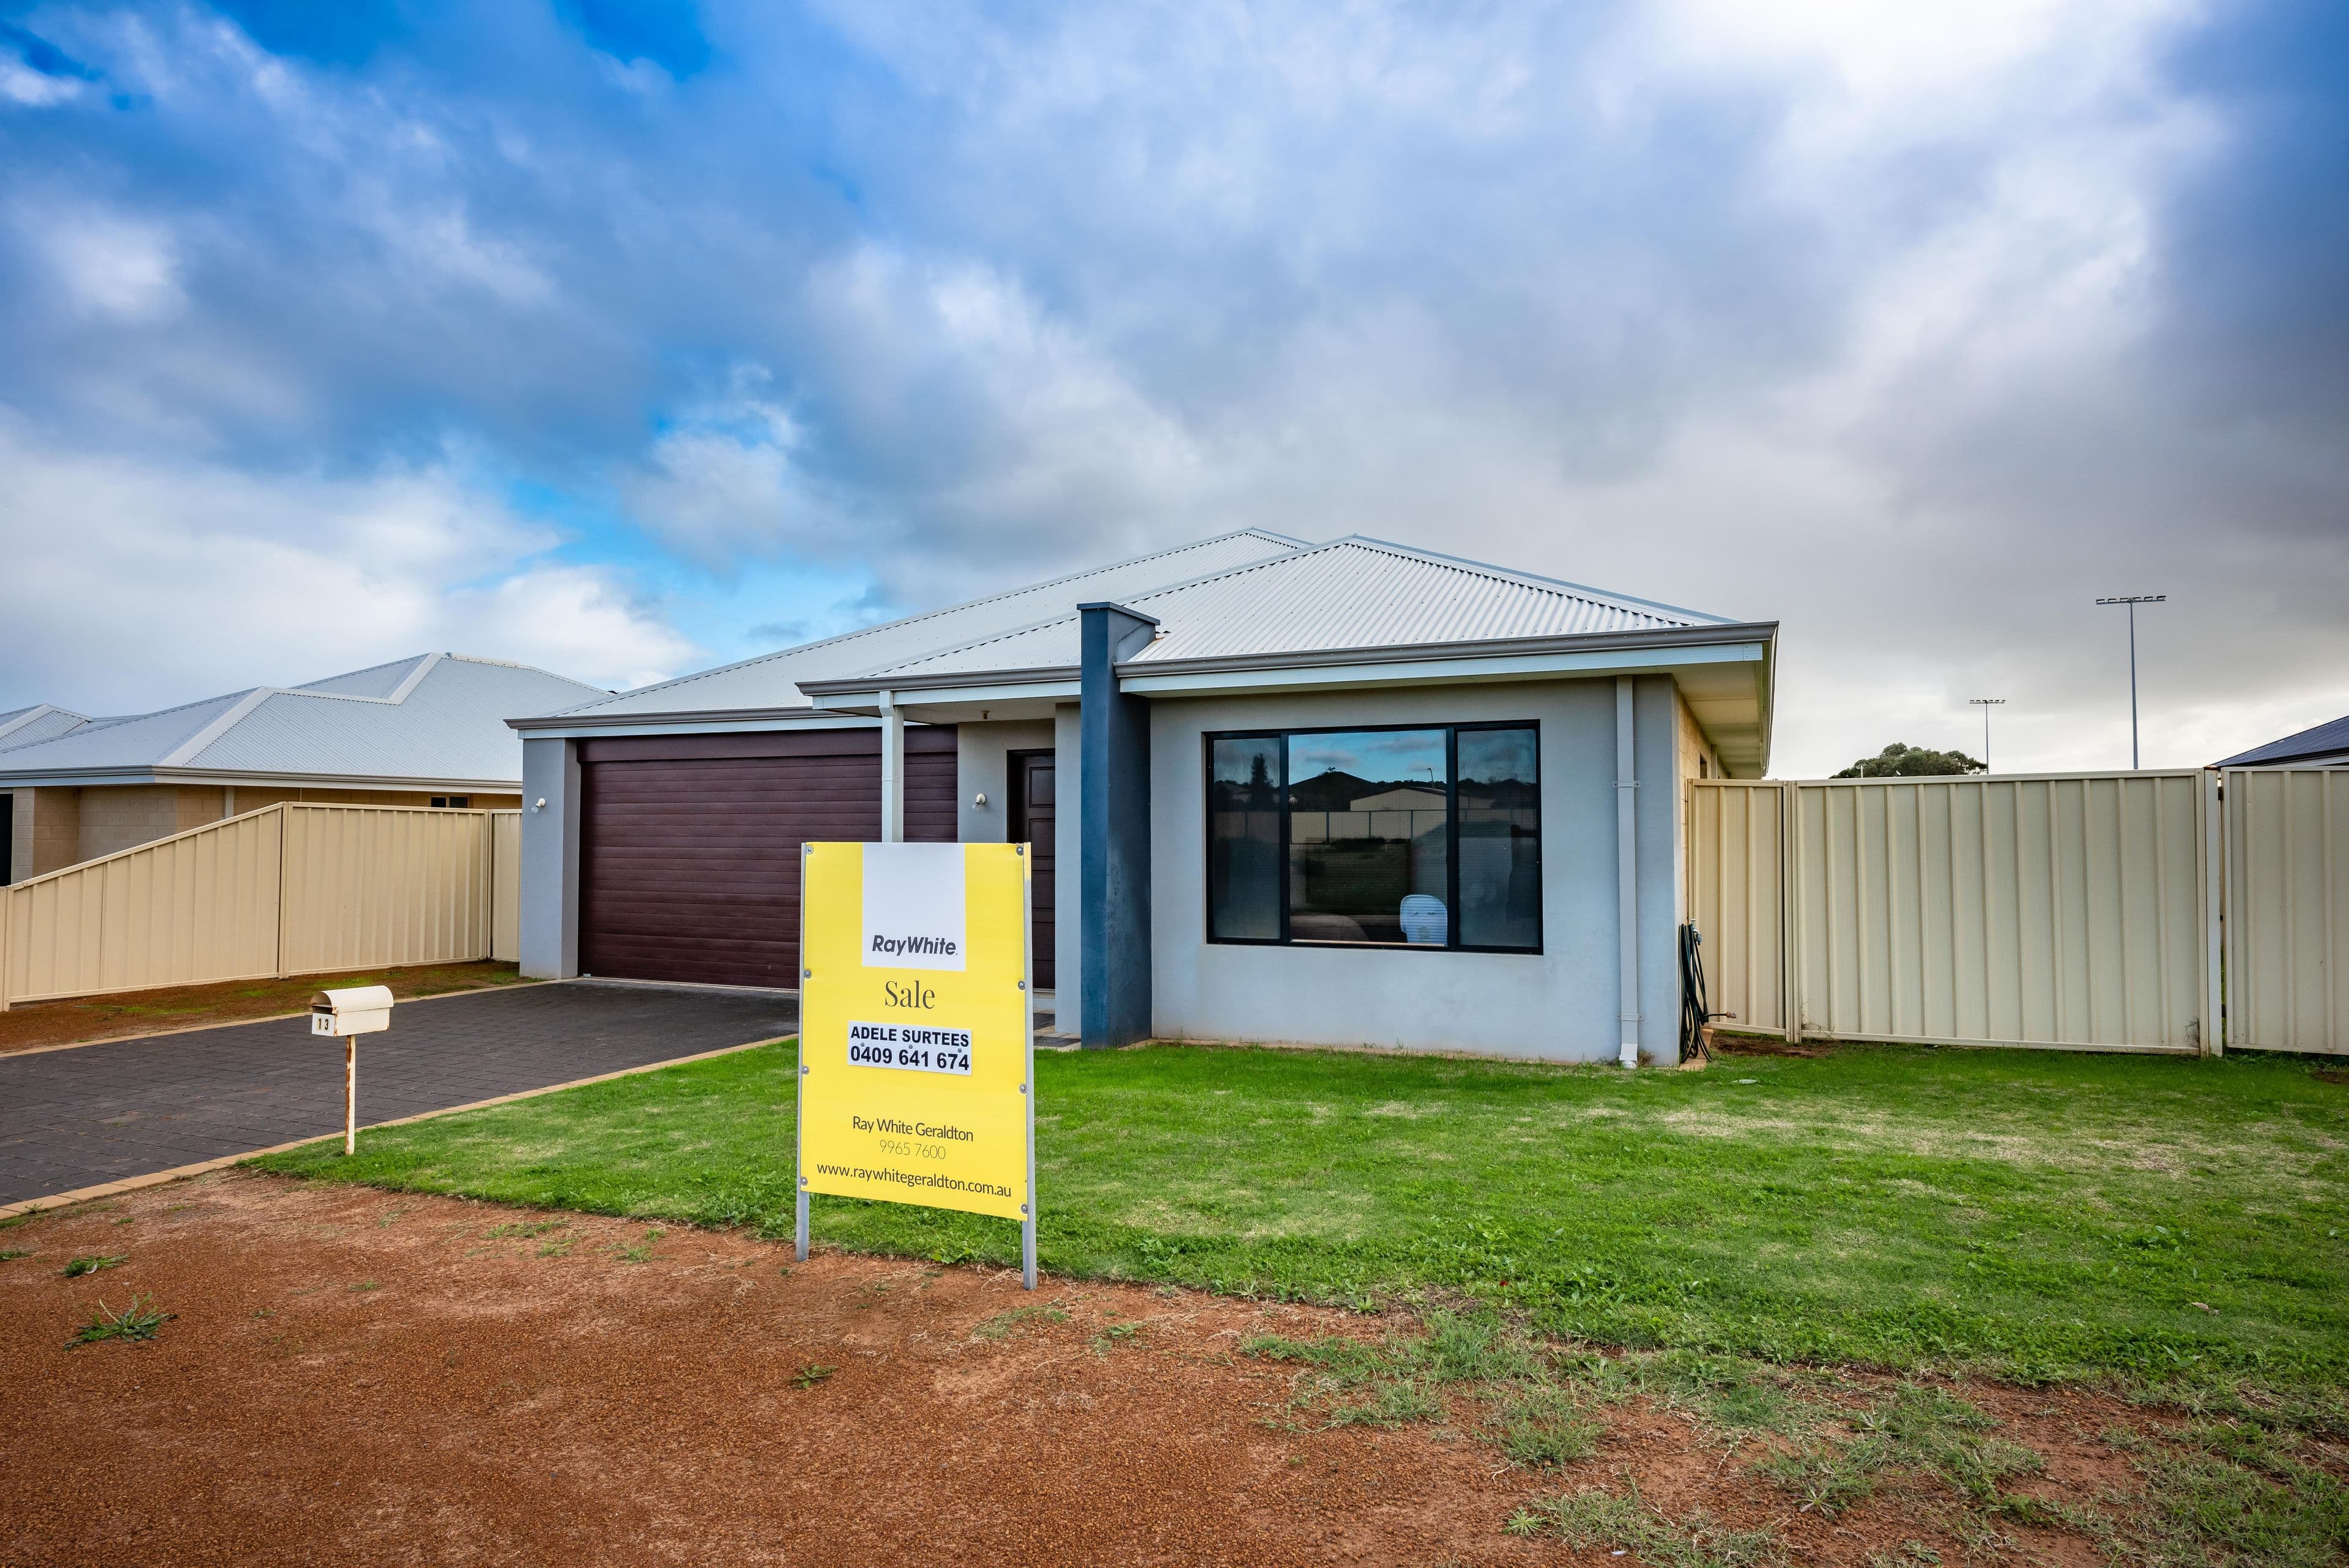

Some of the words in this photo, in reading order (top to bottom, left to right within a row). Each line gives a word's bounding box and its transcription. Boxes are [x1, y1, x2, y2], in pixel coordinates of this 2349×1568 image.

[872, 935, 956, 956] RayWhite
[885, 980, 935, 1009] Sale
[319, 1019, 328, 1030] 13
[850, 1026, 897, 1041] ADELE
[902, 1029, 969, 1047] SURTEES
[850, 1046, 892, 1064] 0409
[899, 1049, 929, 1068] 641
[937, 1052, 970, 1071] 674
[853, 1116, 874, 1133] Ray
[877, 1118, 913, 1135] White
[915, 1122, 974, 1142] Geraldton
[880, 1140, 910, 1155] 9965
[915, 1143, 946, 1159] 7600
[817, 1164, 1012, 1198] www.raywhitegeraldton.com.au
